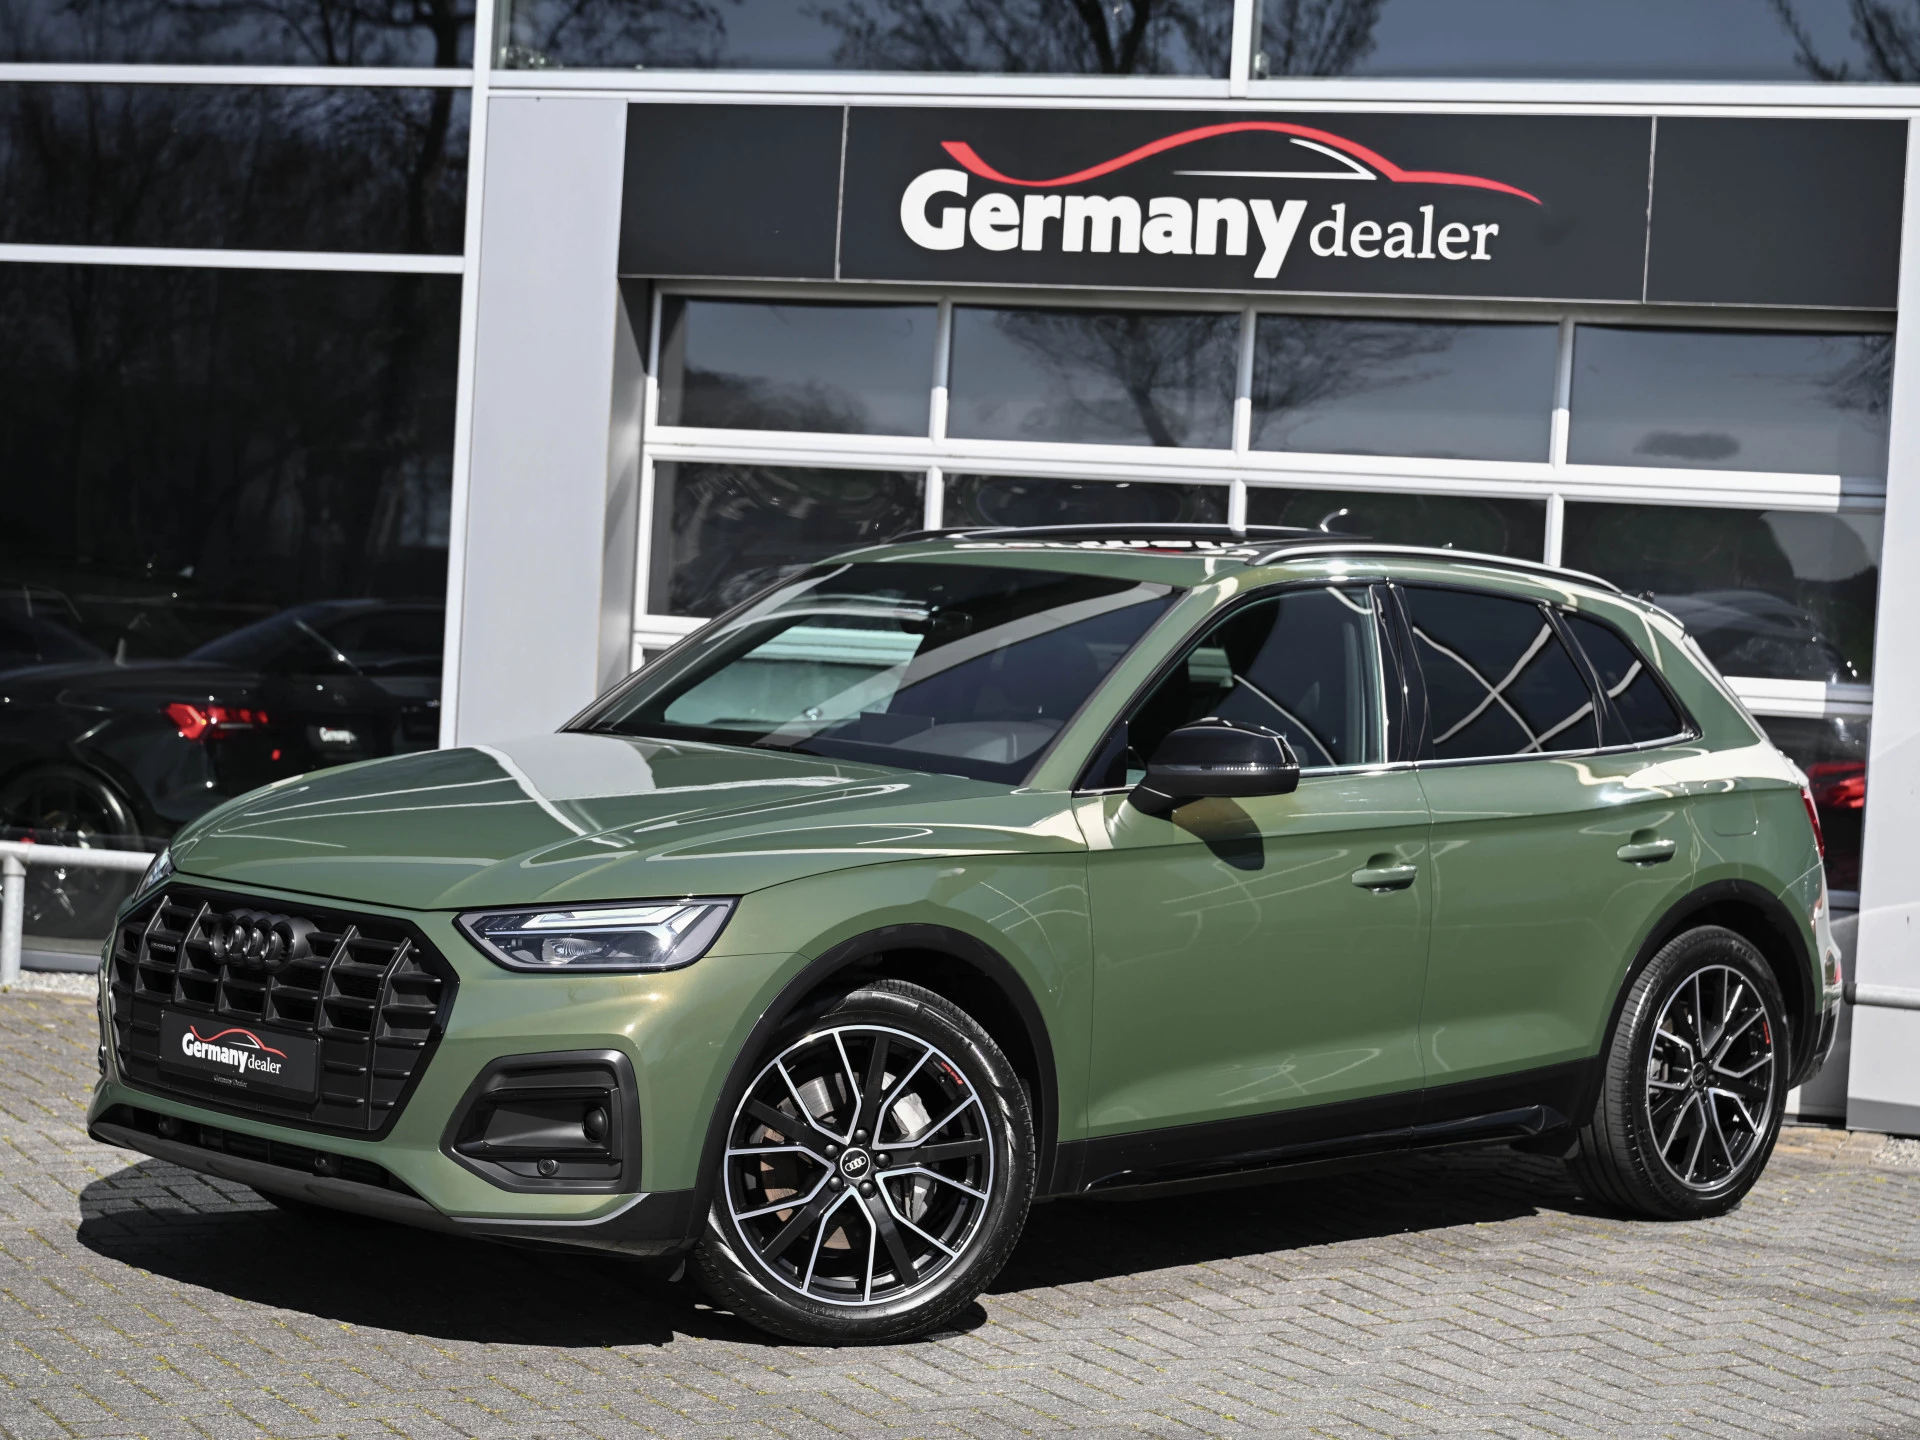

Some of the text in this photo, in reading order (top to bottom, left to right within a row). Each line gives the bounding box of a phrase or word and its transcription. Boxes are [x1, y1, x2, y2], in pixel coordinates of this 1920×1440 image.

[900, 168, 1500, 279] Germany dealer
[181, 1032, 282, 1074] Germany dealer
